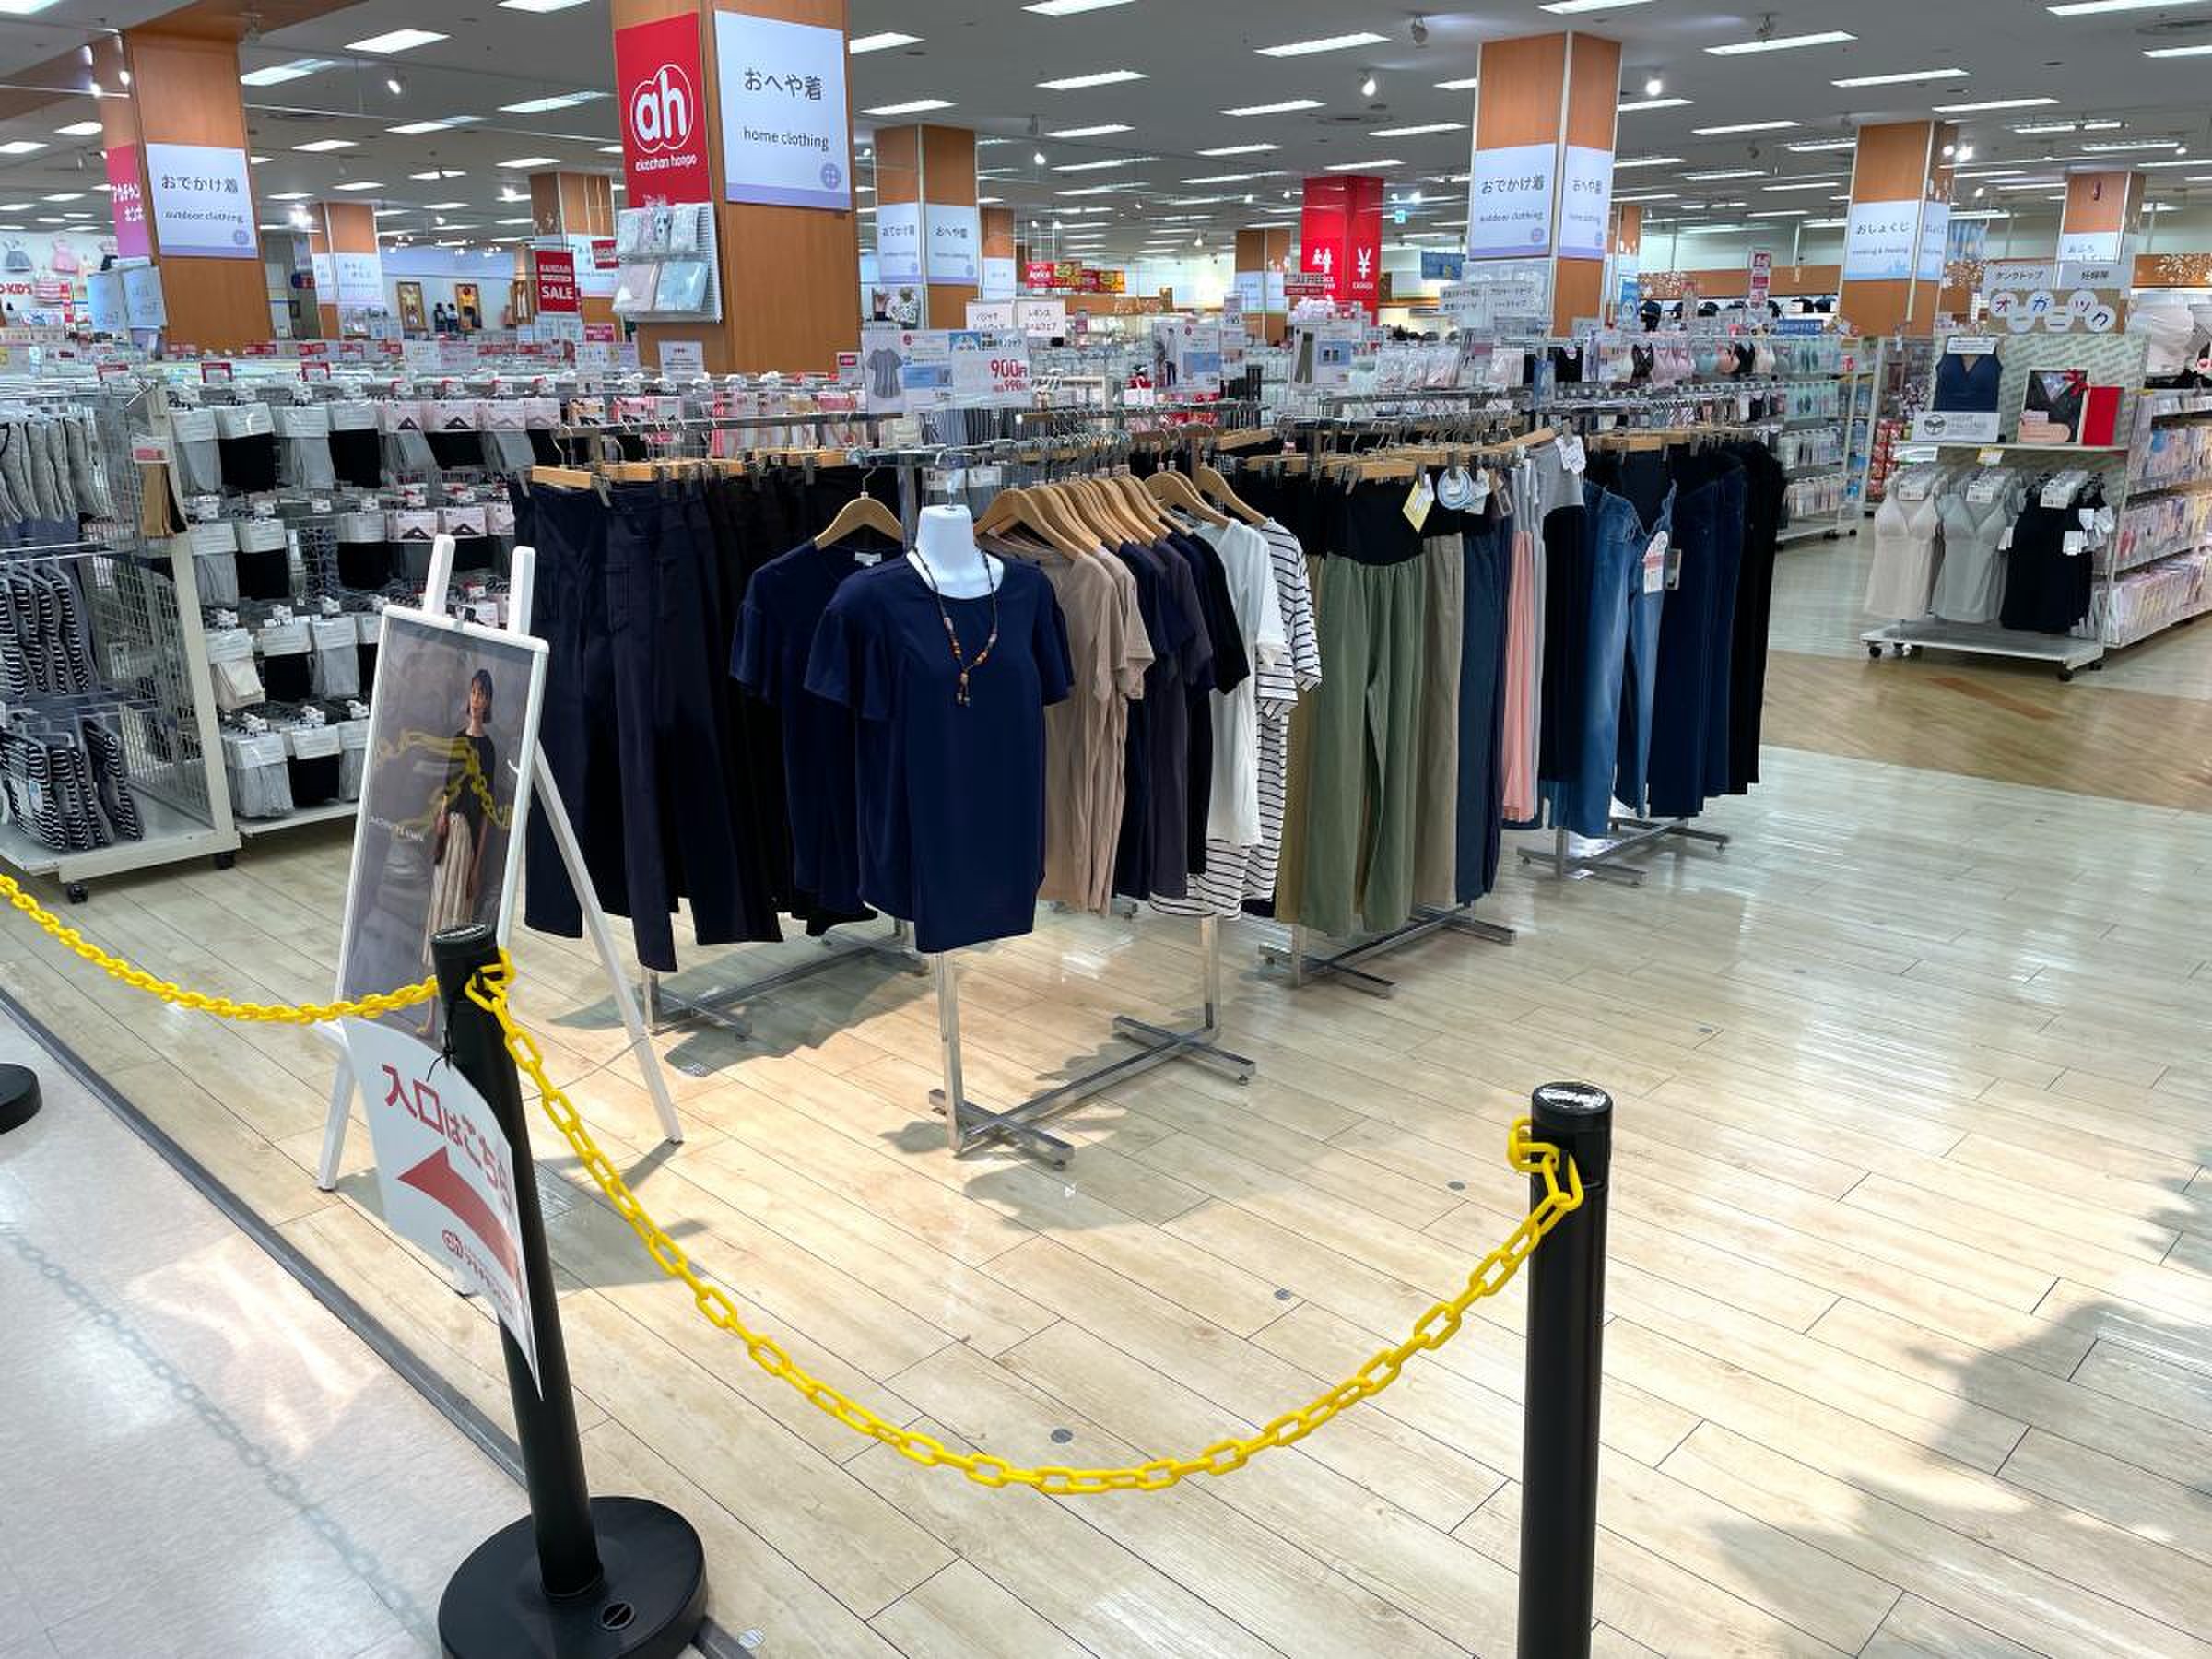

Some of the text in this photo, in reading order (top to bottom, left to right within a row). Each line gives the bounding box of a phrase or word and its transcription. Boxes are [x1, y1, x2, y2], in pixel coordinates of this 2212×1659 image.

[744, 67, 823, 101] おへや着
[635, 69, 687, 141] ah
[744, 126, 829, 152] home clothing
[161, 175, 239, 194] おでかけ着
[1481, 174, 1545, 194] おでかけ着
[164, 210, 204, 221] outdoor
[1857, 221, 1911, 235] おしょくじ
[1995, 270, 2044, 281] タンクトップ
[542, 285, 574, 300] SALE
[991, 359, 1028, 379] 900円
